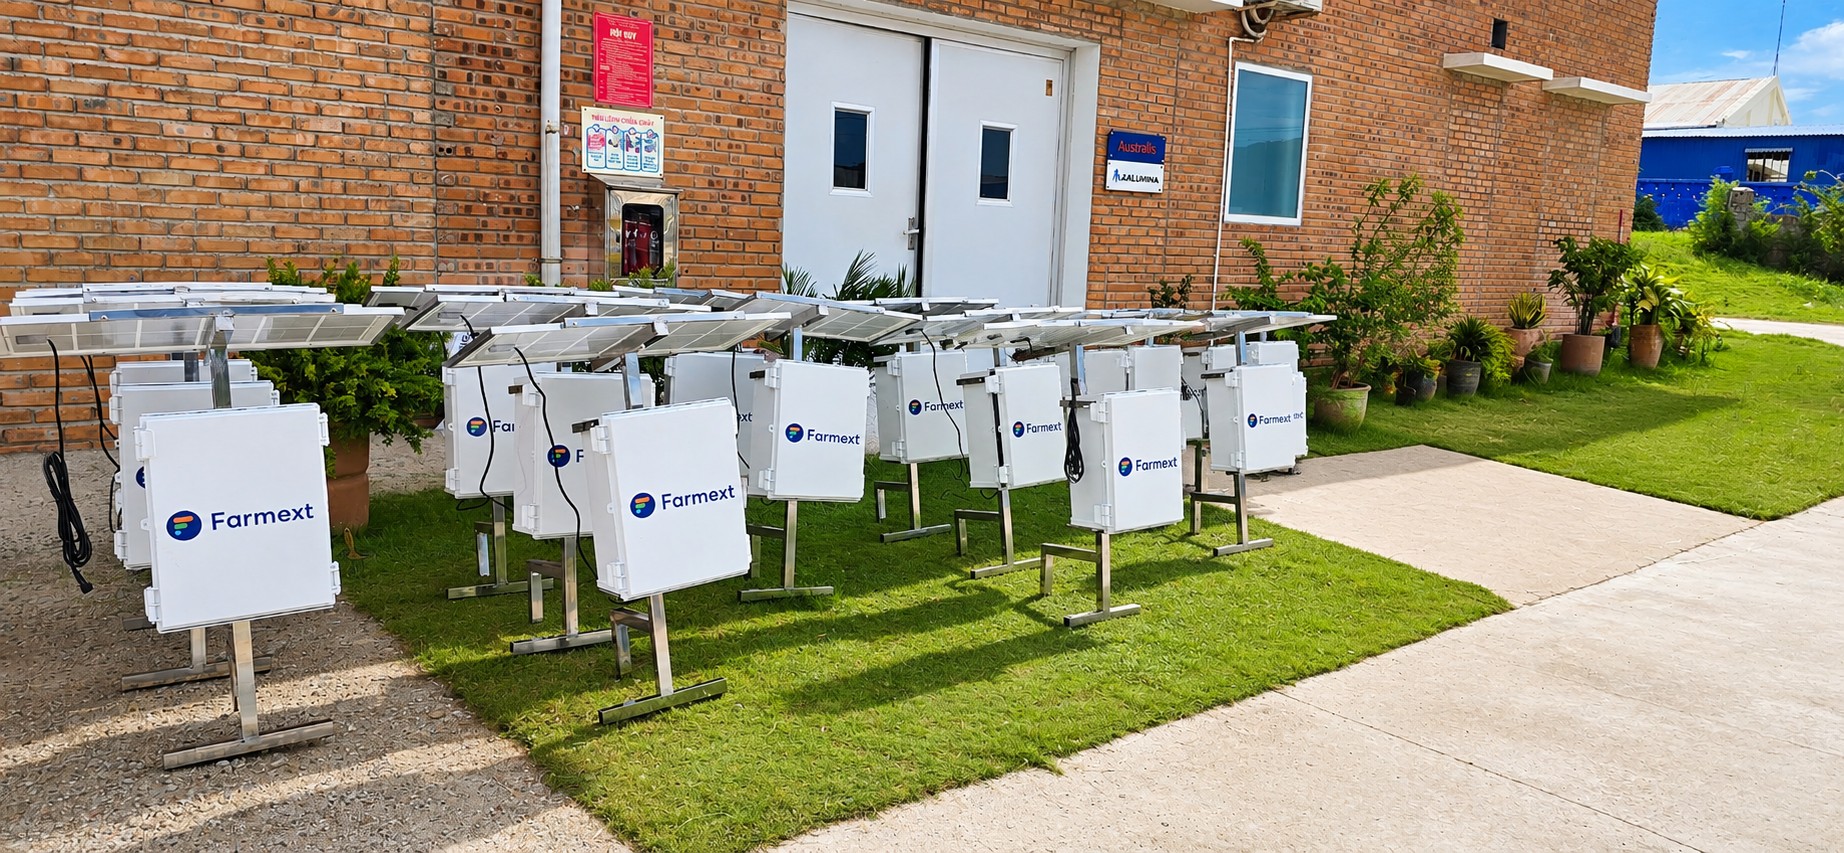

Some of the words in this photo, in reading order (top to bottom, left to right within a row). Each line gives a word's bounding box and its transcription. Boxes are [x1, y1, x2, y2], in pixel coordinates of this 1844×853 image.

[1118, 140, 1157, 155] Australis
[924, 400, 964, 412] Farmext
[1259, 414, 1291, 425] Farmext
[1026, 421, 1062, 434] Farmext
[807, 429, 860, 445] Farmext
[1135, 456, 1178, 472] Farmext
[661, 485, 736, 510] Farmext
[211, 503, 314, 531] Farmext
